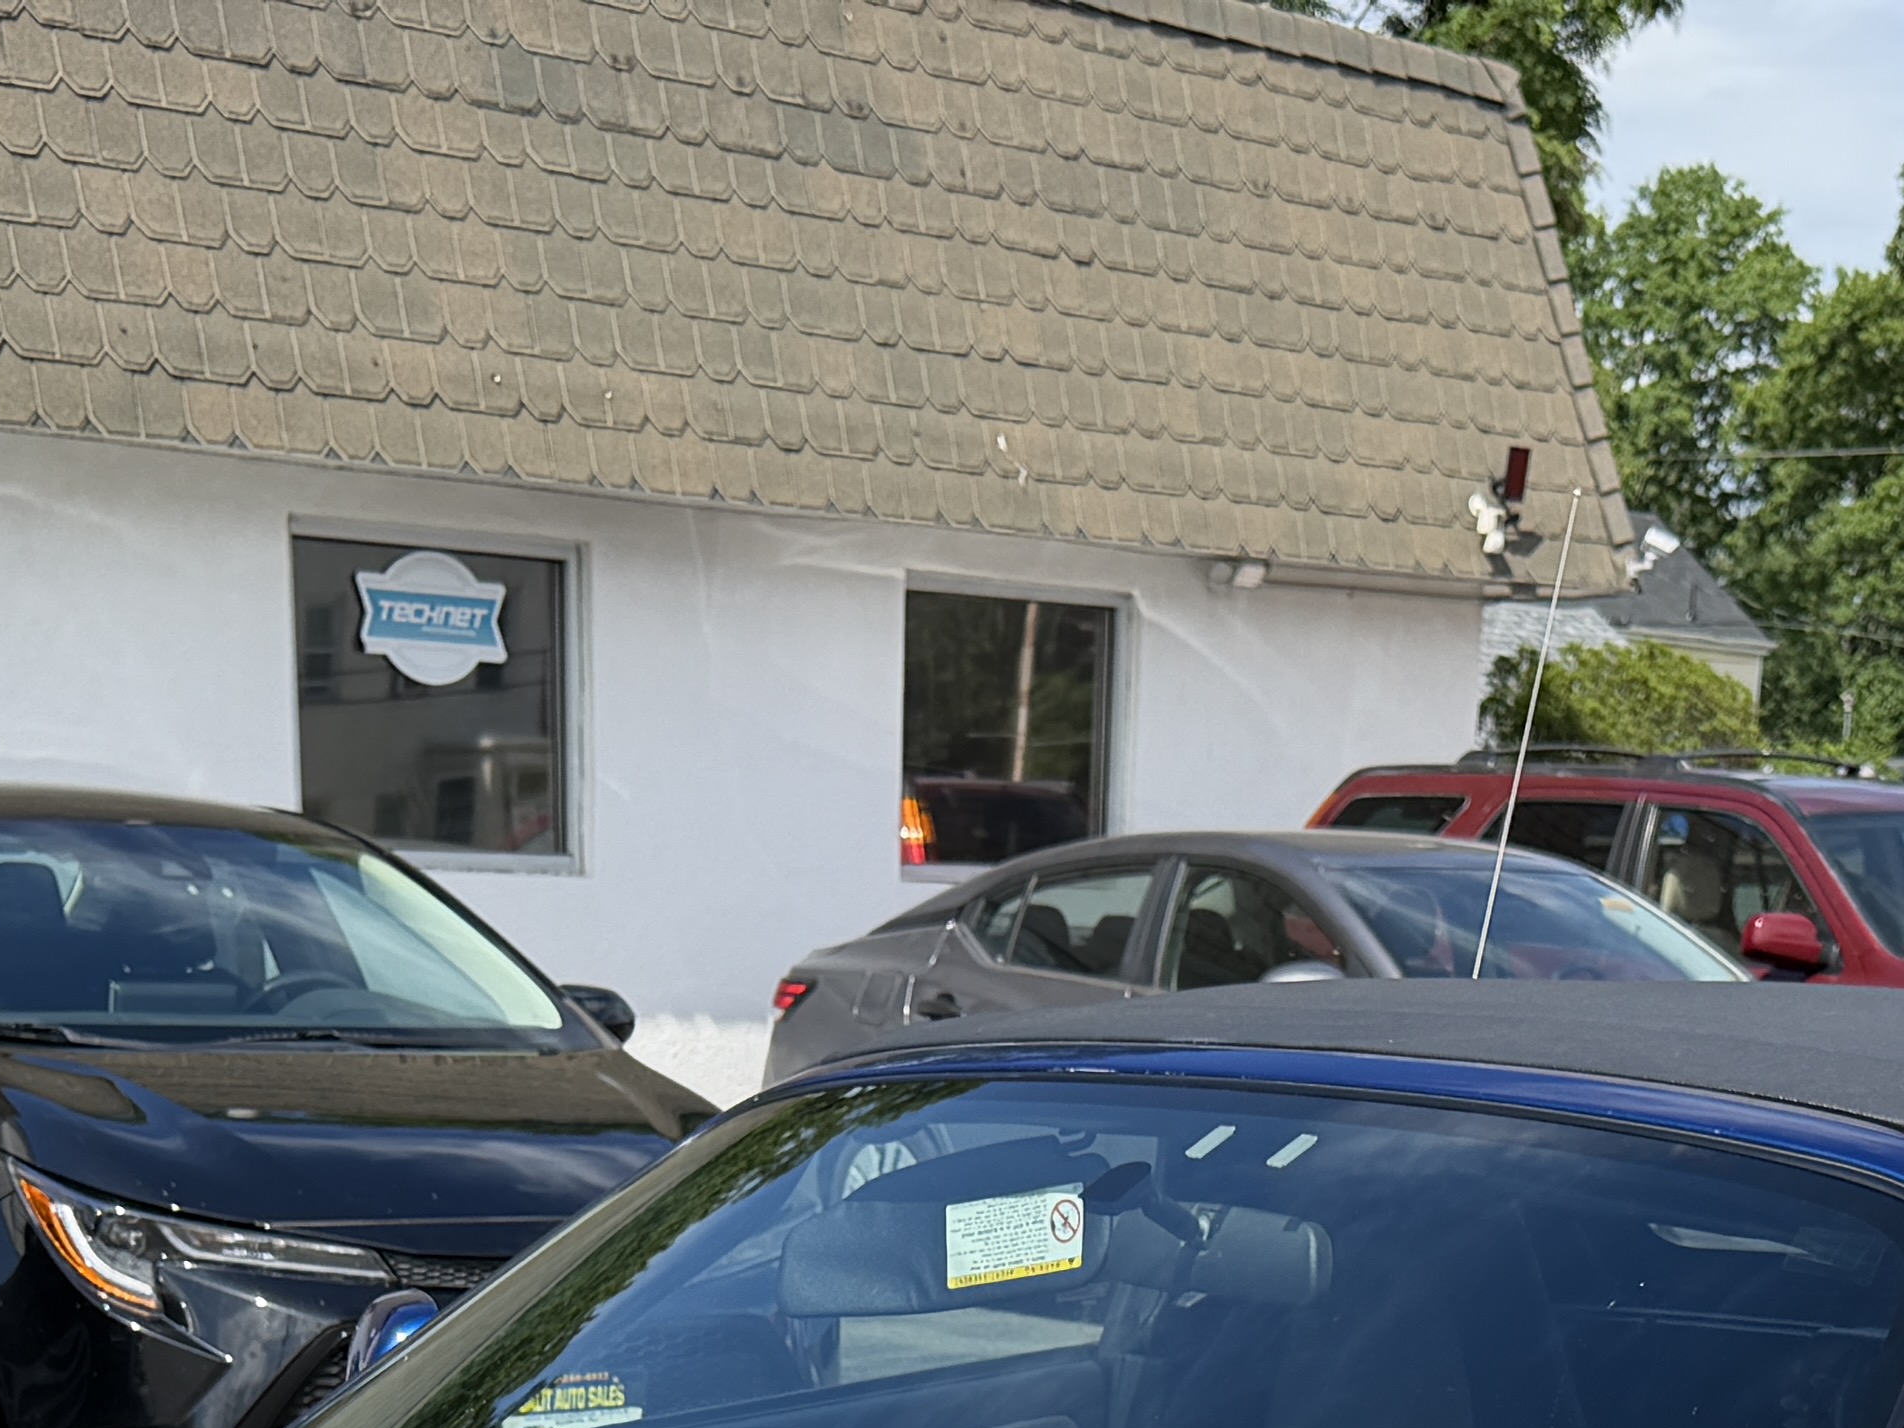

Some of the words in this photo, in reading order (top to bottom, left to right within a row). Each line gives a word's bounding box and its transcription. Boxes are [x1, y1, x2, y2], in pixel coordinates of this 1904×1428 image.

[379, 600, 490, 629] TECHNET
[554, 1385, 587, 1410] AUTO
[588, 1383, 626, 1408] SALES
